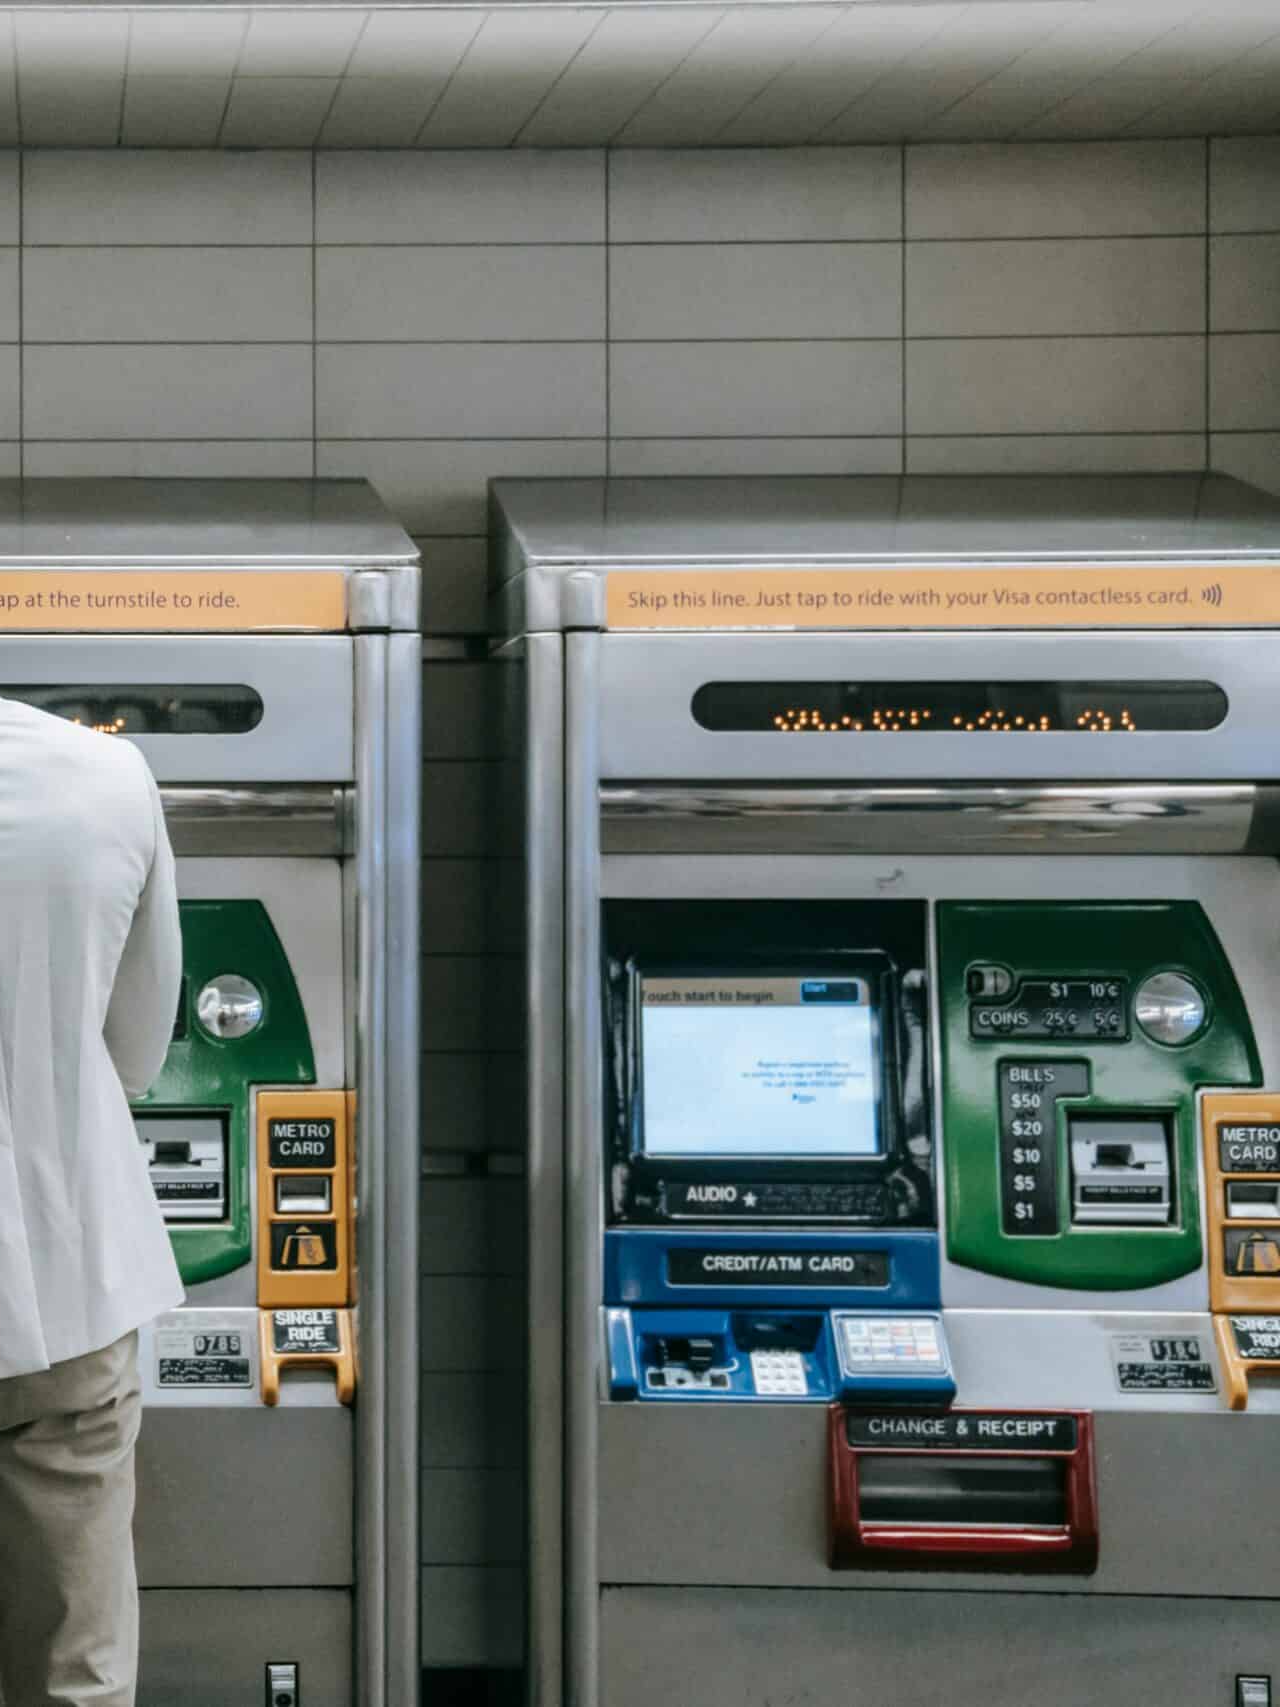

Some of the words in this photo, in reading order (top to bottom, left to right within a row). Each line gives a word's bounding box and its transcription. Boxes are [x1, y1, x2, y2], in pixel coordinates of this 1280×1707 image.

[25, 592, 44, 608] at
[49, 591, 81, 608] the
[87, 591, 168, 608] turnstile
[173, 592, 193, 608] to
[198, 590, 241, 608] ride.
[627, 591, 667, 611] Skip
[672, 591, 707, 608] this
[756, 591, 791, 607] Just
[797, 591, 828, 610] tap
[833, 591, 852, 606] to
[858, 590, 894, 606] ride
[900, 588, 941, 606] with
[946, 591, 989, 609] your
[993, 588, 1031, 605] Visa
[1036, 588, 1142, 606] contactless
[1051, 983, 1068, 997] $1
[979, 1012, 1029, 1026] COINS
[1010, 1068, 1055, 1082] BILLS
[1011, 1093, 1041, 1109] $50
[274, 1124, 331, 1138] METRO
[1012, 1120, 1042, 1136] $20
[1223, 1128, 1280, 1142] METRO
[279, 1141, 325, 1156] CARD
[1012, 1148, 1040, 1164] $10
[1230, 1145, 1277, 1160] CARD
[1014, 1175, 1035, 1191] $5
[686, 1187, 737, 1202] AUDIO
[1015, 1202, 1034, 1219] $1
[702, 1257, 802, 1272] CREDIT/ATM
[808, 1256, 855, 1272] CARD
[275, 1311, 334, 1325] SINGLE
[288, 1326, 326, 1341] RIDE
[868, 1419, 945, 1435] CHANGE
[956, 1420, 968, 1435] &
[977, 1420, 1057, 1437] RECEIPT
